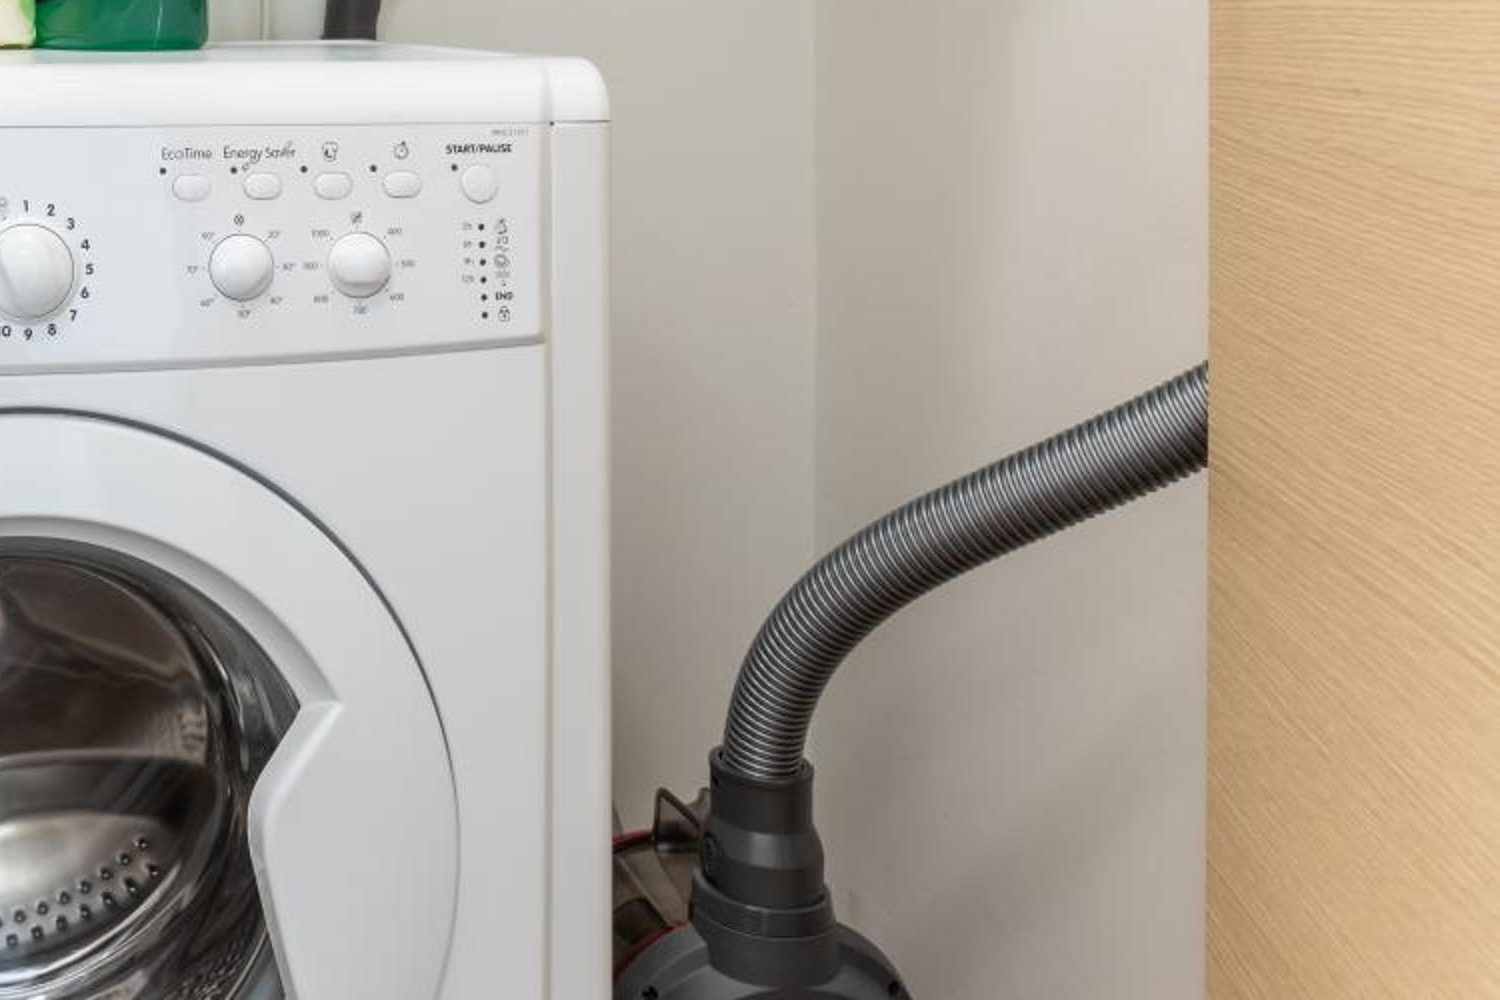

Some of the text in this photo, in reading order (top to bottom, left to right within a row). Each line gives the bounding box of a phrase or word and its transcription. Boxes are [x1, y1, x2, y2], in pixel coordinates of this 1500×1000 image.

[161, 147, 213, 161] EcoTime
[223, 146, 262, 164] Energy
[445, 143, 512, 155] START/PAUSE
[23, 200, 29, 212] 1
[47, 204, 55, 216] 2
[67, 218, 75, 230] 3
[81, 239, 90, 251] 4
[85, 263, 94, 275] 5
[80, 286, 89, 298] 6
[69, 309, 77, 321] 7
[24, 328, 33, 340] 9
[48, 323, 56, 336] 8
